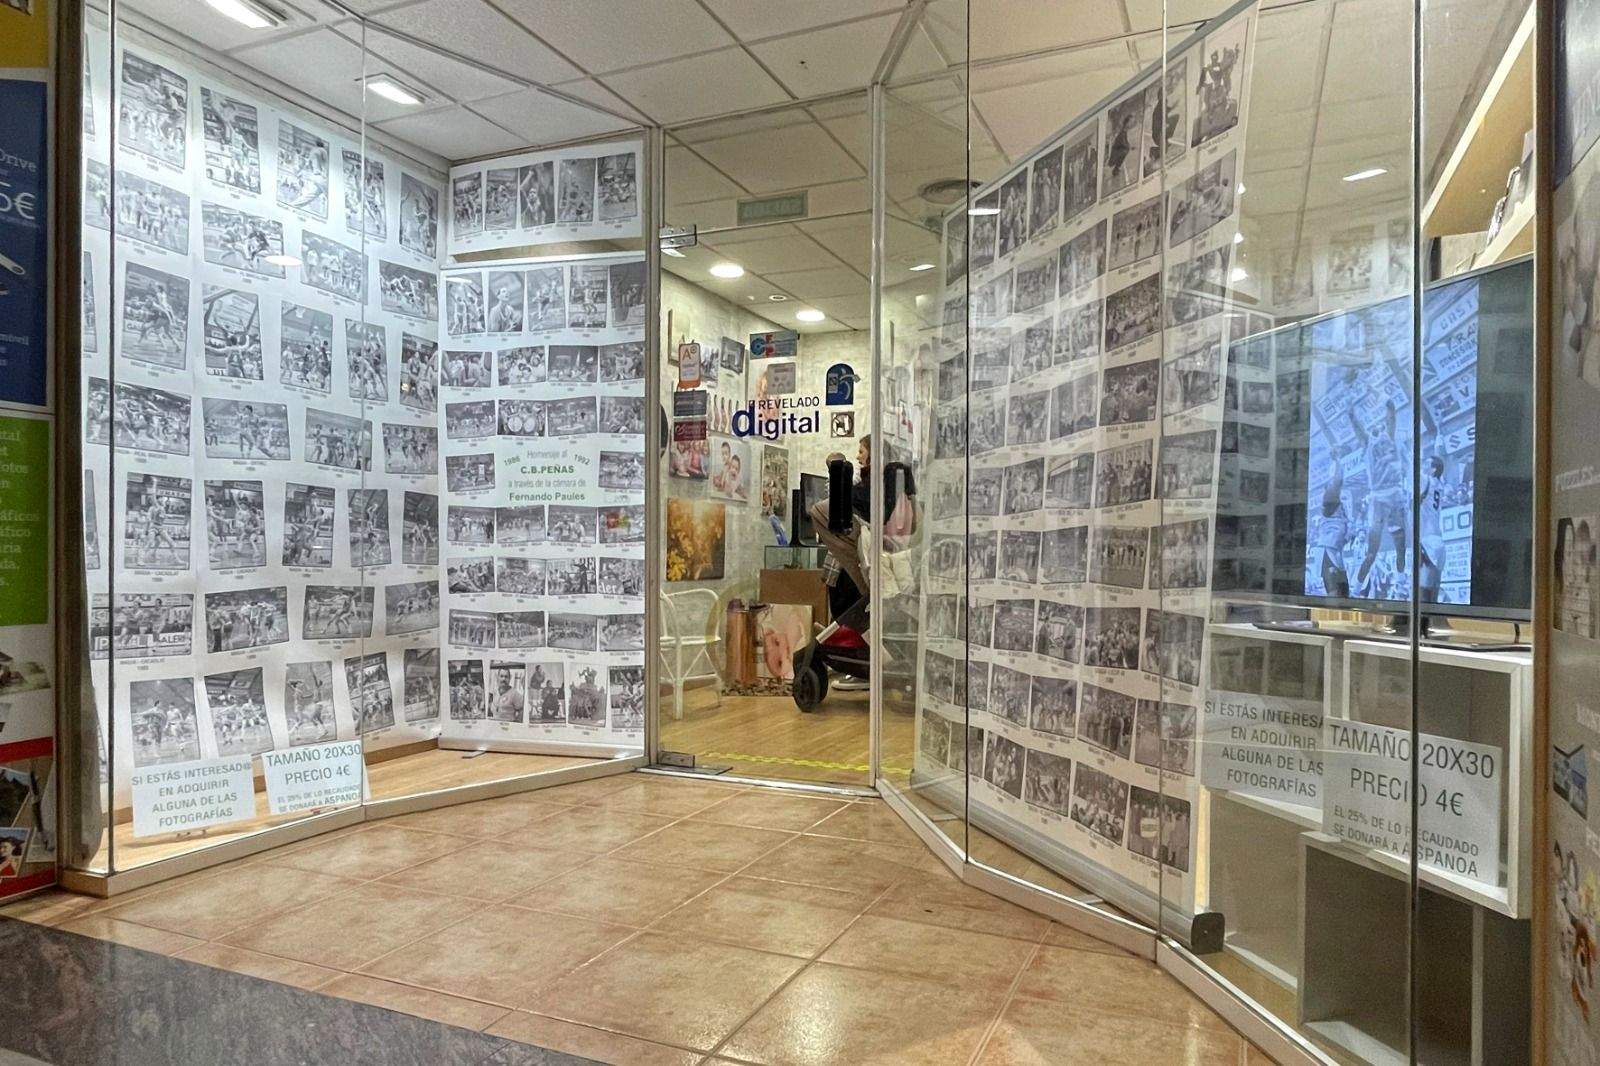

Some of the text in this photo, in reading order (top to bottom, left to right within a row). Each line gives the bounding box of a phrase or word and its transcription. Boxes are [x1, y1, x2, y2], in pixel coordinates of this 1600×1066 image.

[758, 396, 820, 410] REVELADO
[731, 399, 820, 441] digital
[520, 463, 575, 475] C.B.PEÑAS
[574, 453, 591, 466] 1992
[509, 492, 553, 502] Fernando
[1204, 700, 1216, 714] SI
[1220, 702, 1258, 720] ESTÁS
[1231, 726, 1317, 752] EN ADQUIRIR
[266, 743, 361, 768] TAMAÑO 20X30
[1221, 747, 1325, 777] ALGUNA DE LAS
[1330, 724, 1495, 780] TAMAÑO 20X30
[132, 776, 143, 786] SI
[146, 769, 181, 785] ESTÁS
[285, 764, 352, 785] PRECIO 4€
[1227, 768, 1318, 798] FOTOGRAFÍAS
[159, 778, 230, 798] EN ADQUIRIR
[152, 792, 238, 814] ALGUNA DE LAS
[1435, 789, 1465, 817] 4€
[159, 806, 233, 828] FOTOGRAFÍAS
[1334, 804, 1345, 818] EL
[1348, 810, 1369, 825] 25%
[1371, 816, 1385, 830] DE
[1388, 821, 1402, 835] LO
[1334, 823, 1345, 836] SE
[1347, 827, 1389, 851] DONARÁ
[1392, 843, 1400, 853] A
